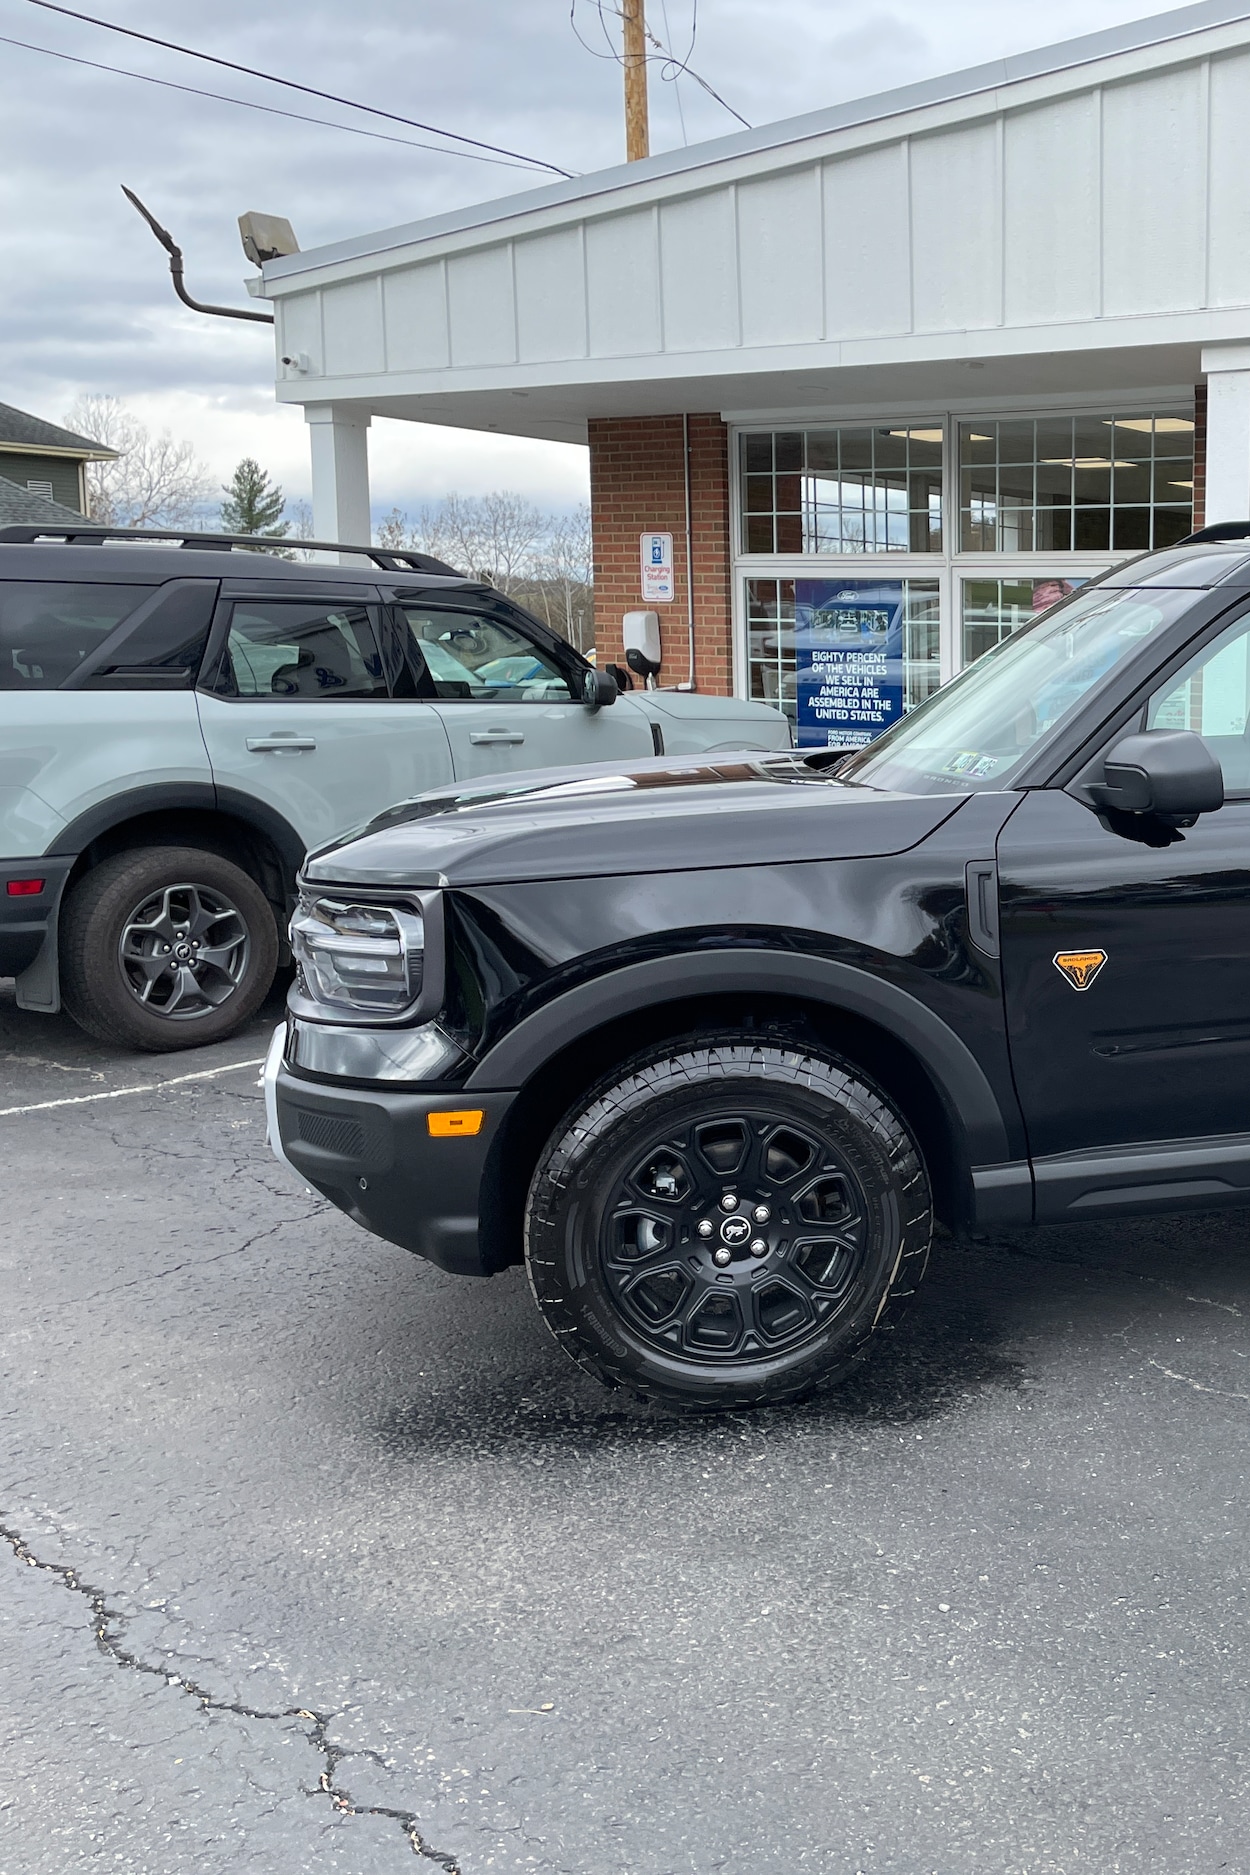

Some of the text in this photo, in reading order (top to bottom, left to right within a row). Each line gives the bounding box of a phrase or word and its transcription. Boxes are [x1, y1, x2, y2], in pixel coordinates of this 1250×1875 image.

[645, 565, 670, 575] Charging
[812, 651, 887, 664] EIGHTY PERCENT
[812, 663, 887, 675] OF THE VEHICLES
[825, 675, 874, 686] WE SELL IN
[820, 686, 879, 698] AMERICA ARE
[808, 697, 892, 711] ASSEMBLED IN THE
[816, 708, 884, 722] UNITED STATES.
[828, 734, 844, 742] FROM
